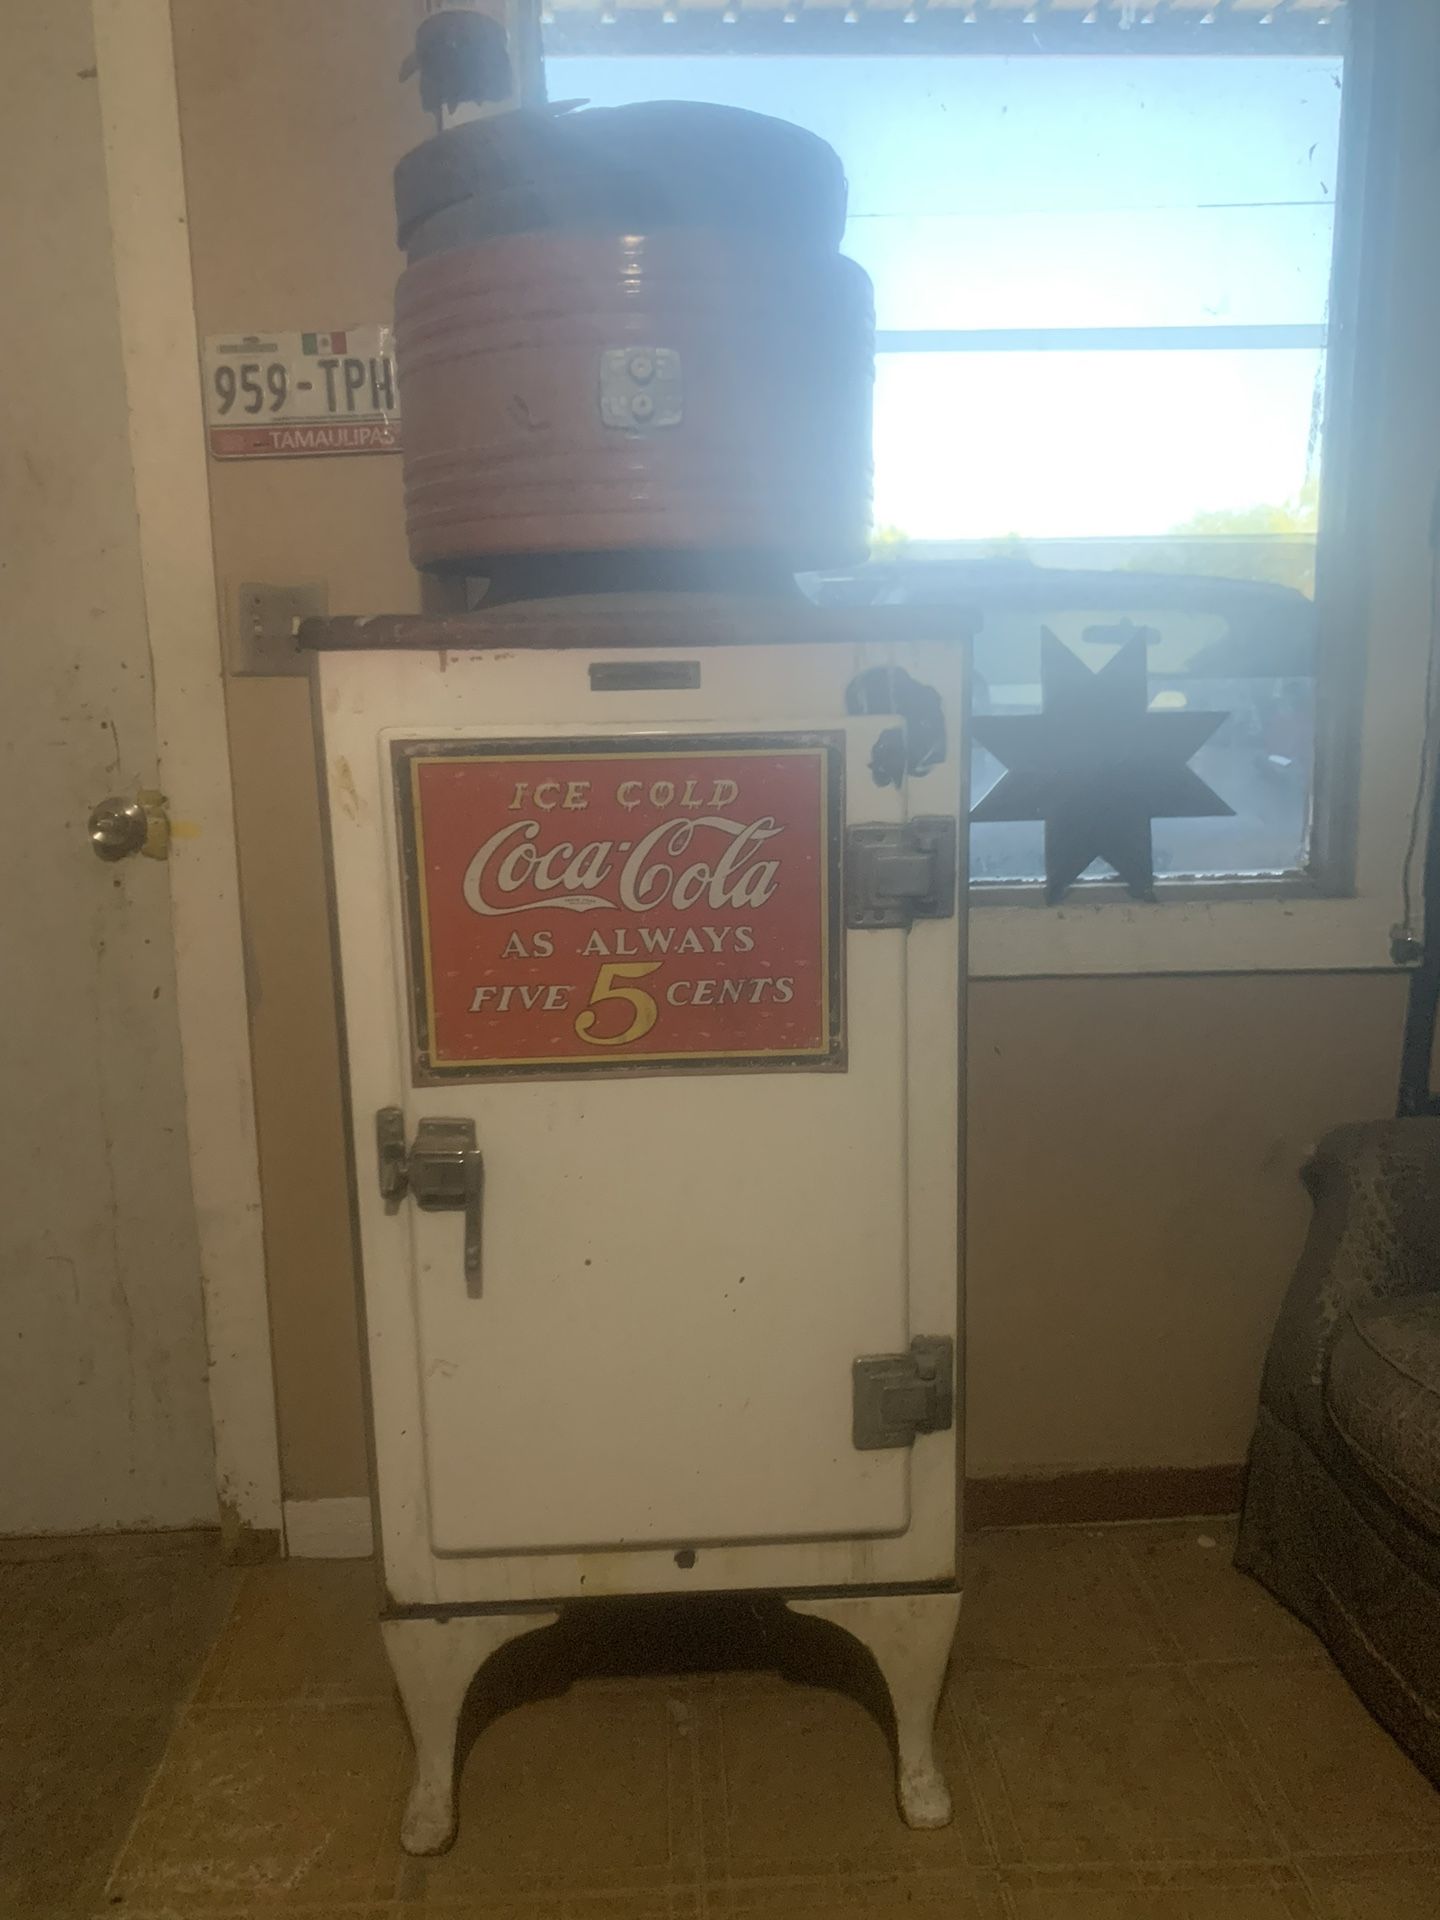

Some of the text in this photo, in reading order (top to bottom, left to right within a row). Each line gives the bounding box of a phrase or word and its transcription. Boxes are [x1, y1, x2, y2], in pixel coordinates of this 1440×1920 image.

[269, 426, 395, 449] TAMAULIPAS
[508, 779, 739, 812] ICE COLD
[463, 816, 785, 916] Coca-Cola
[502, 926, 755, 958] AS ALWAYS
[469, 961, 795, 1045] FIVE 5 CENTS
